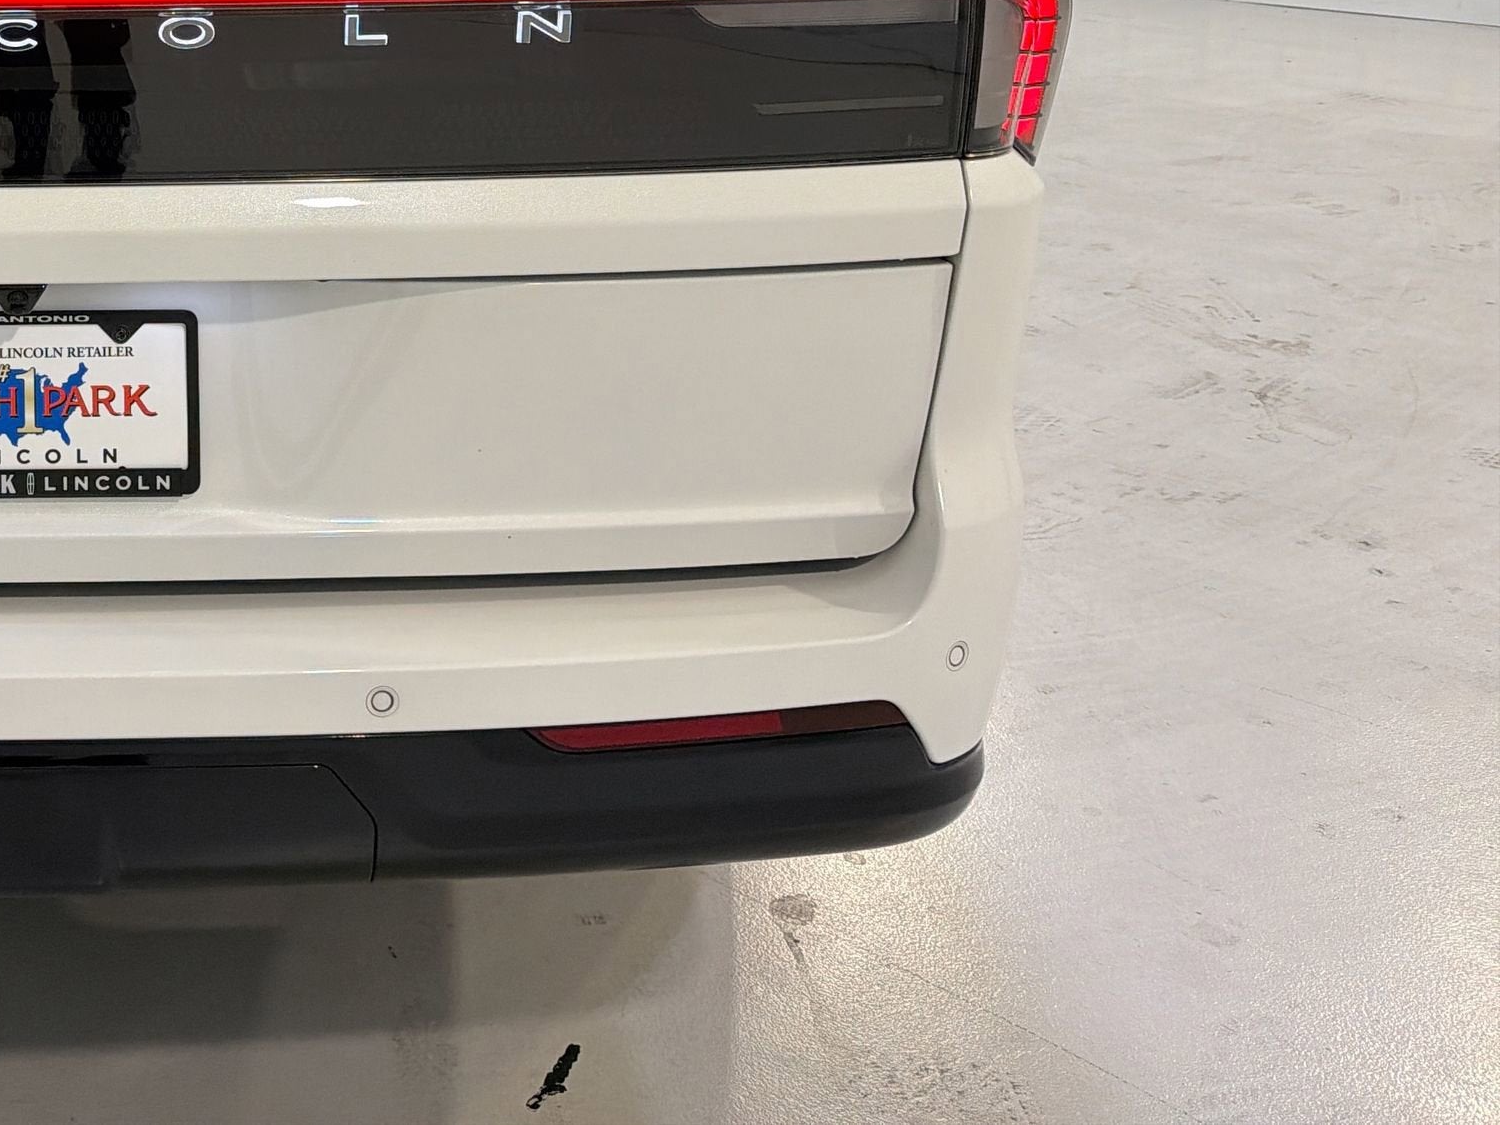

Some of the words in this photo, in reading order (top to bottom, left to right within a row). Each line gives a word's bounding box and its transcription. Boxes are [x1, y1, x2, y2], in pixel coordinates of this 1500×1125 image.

[66, 345, 134, 358] RETAILER
[41, 384, 159, 418] PARK
[43, 474, 172, 492] LINCOLN
